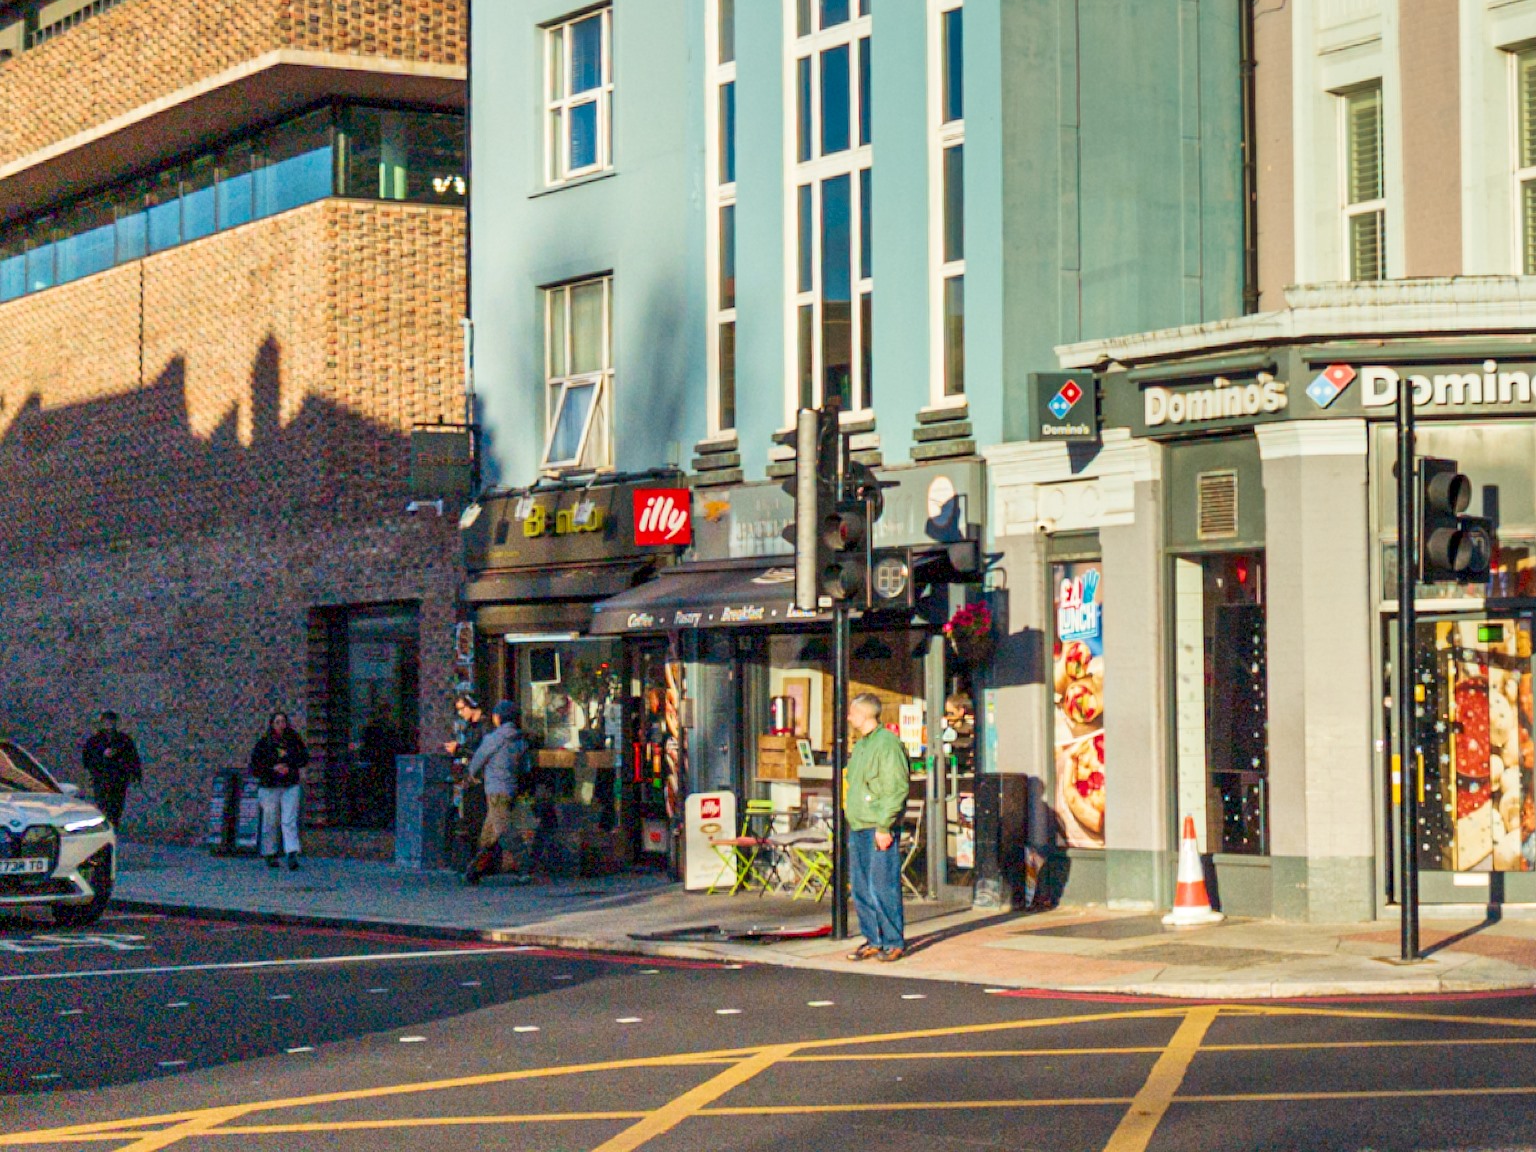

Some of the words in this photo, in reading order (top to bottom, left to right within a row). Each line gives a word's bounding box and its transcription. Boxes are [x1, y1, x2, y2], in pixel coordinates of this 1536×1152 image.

[1144, 372, 1288, 426] Domino's
[1042, 422, 1090, 435] Domino's
[638, 496, 688, 540] illy
[1058, 601, 1097, 634] LUNCH
